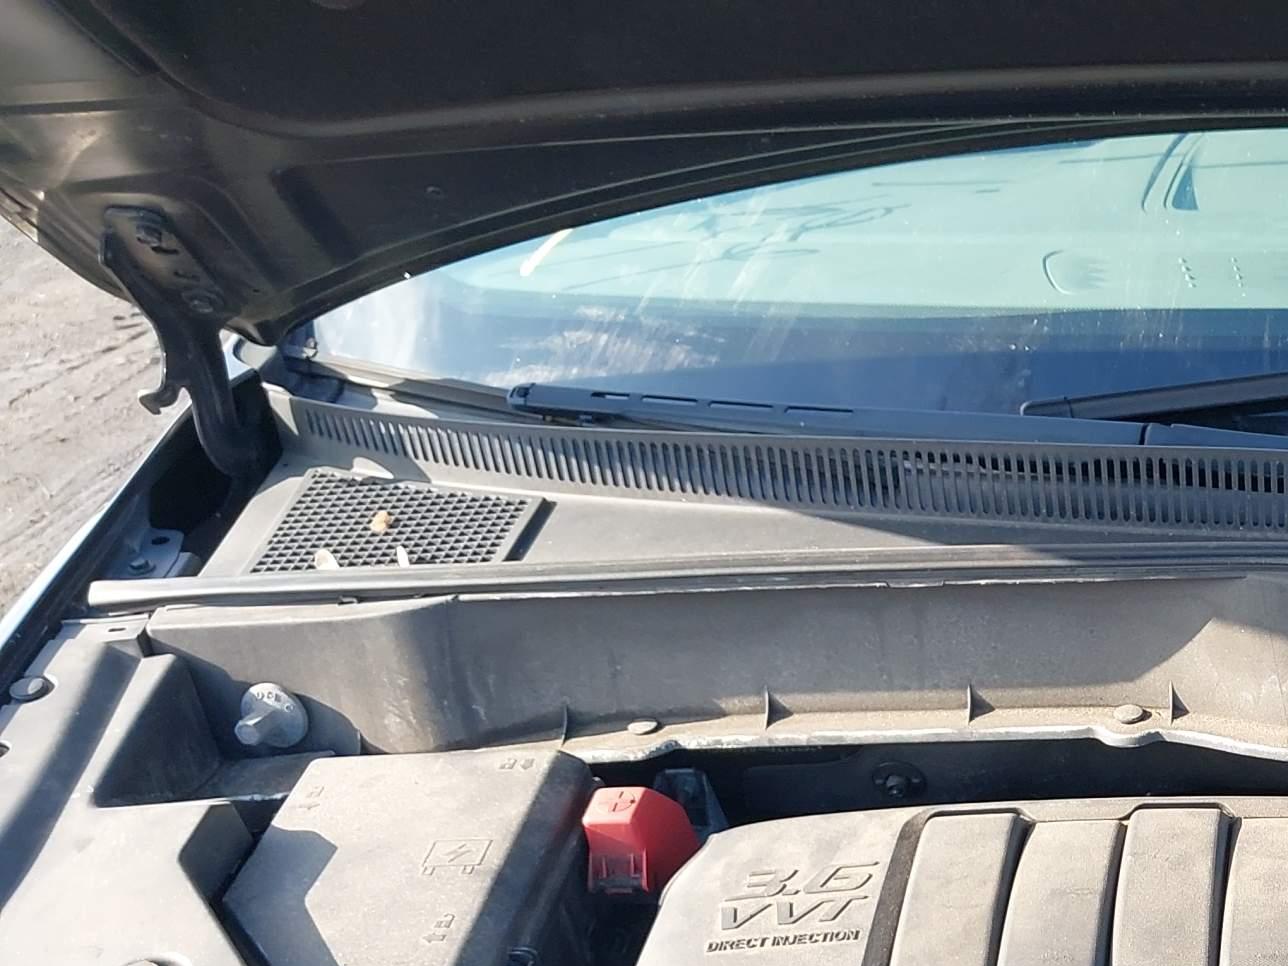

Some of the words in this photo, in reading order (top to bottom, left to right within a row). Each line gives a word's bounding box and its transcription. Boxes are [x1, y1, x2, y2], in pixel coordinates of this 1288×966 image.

[724, 860, 880, 903] 3.6
[721, 895, 870, 931] VVT
[706, 936, 770, 953] DIRECT
[771, 929, 862, 947] INJECTION
